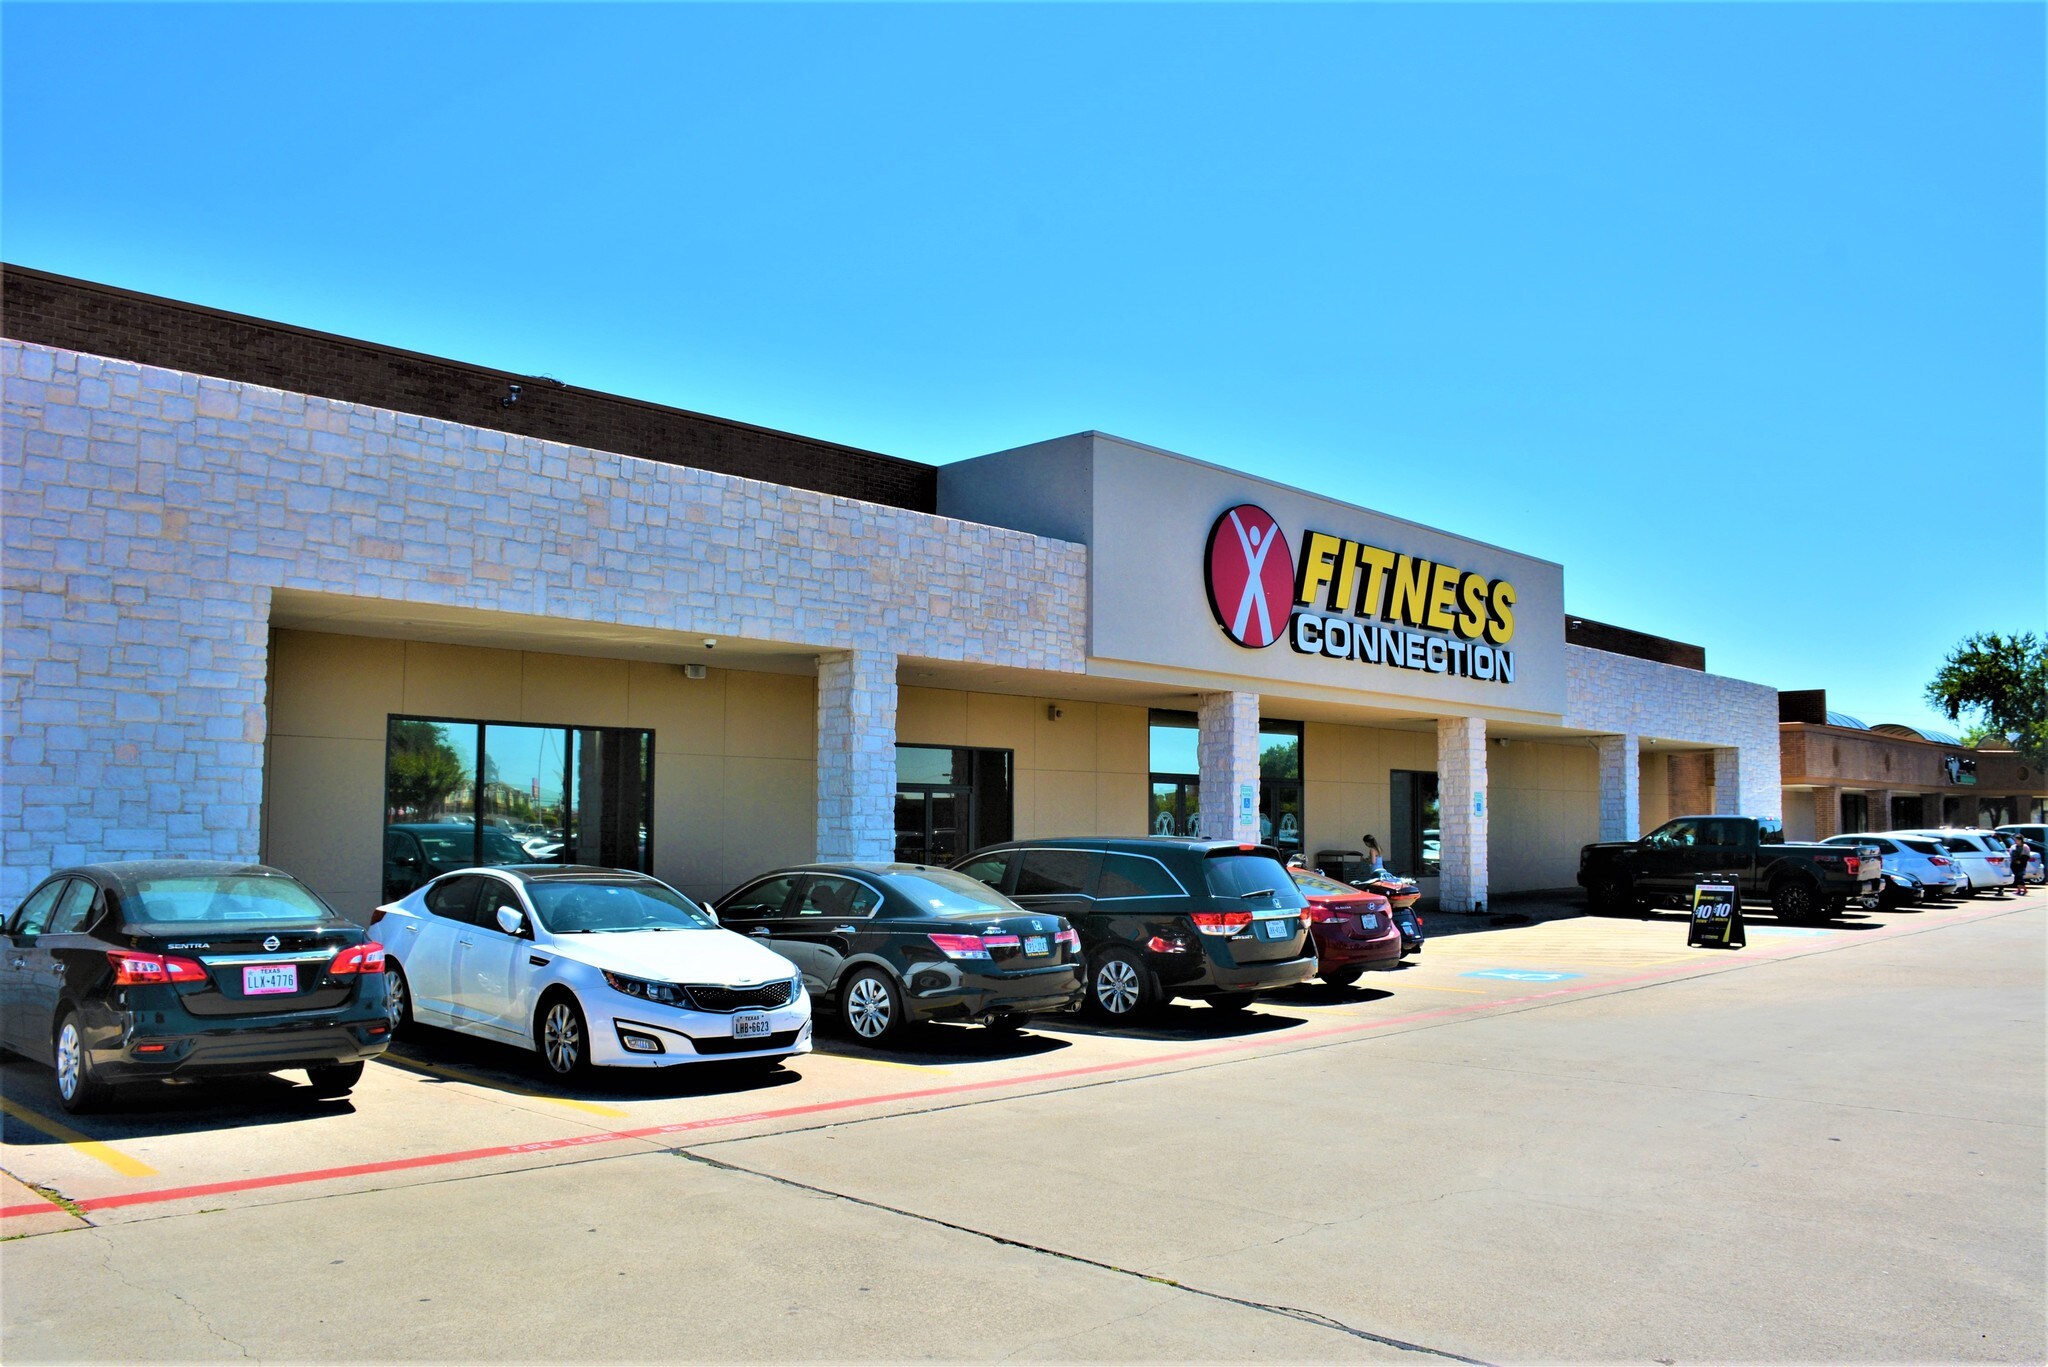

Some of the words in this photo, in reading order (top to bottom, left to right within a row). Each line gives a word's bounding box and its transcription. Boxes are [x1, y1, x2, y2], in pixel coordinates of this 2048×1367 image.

[1300, 531, 1517, 645] FITNESS
[1294, 613, 1516, 684] CONNECTION
[508, 1138, 554, 1152] FIRE
[564, 1132, 619, 1146] LANE
[660, 1123, 688, 1135] NO
[698, 1113, 768, 1127] PARKING
